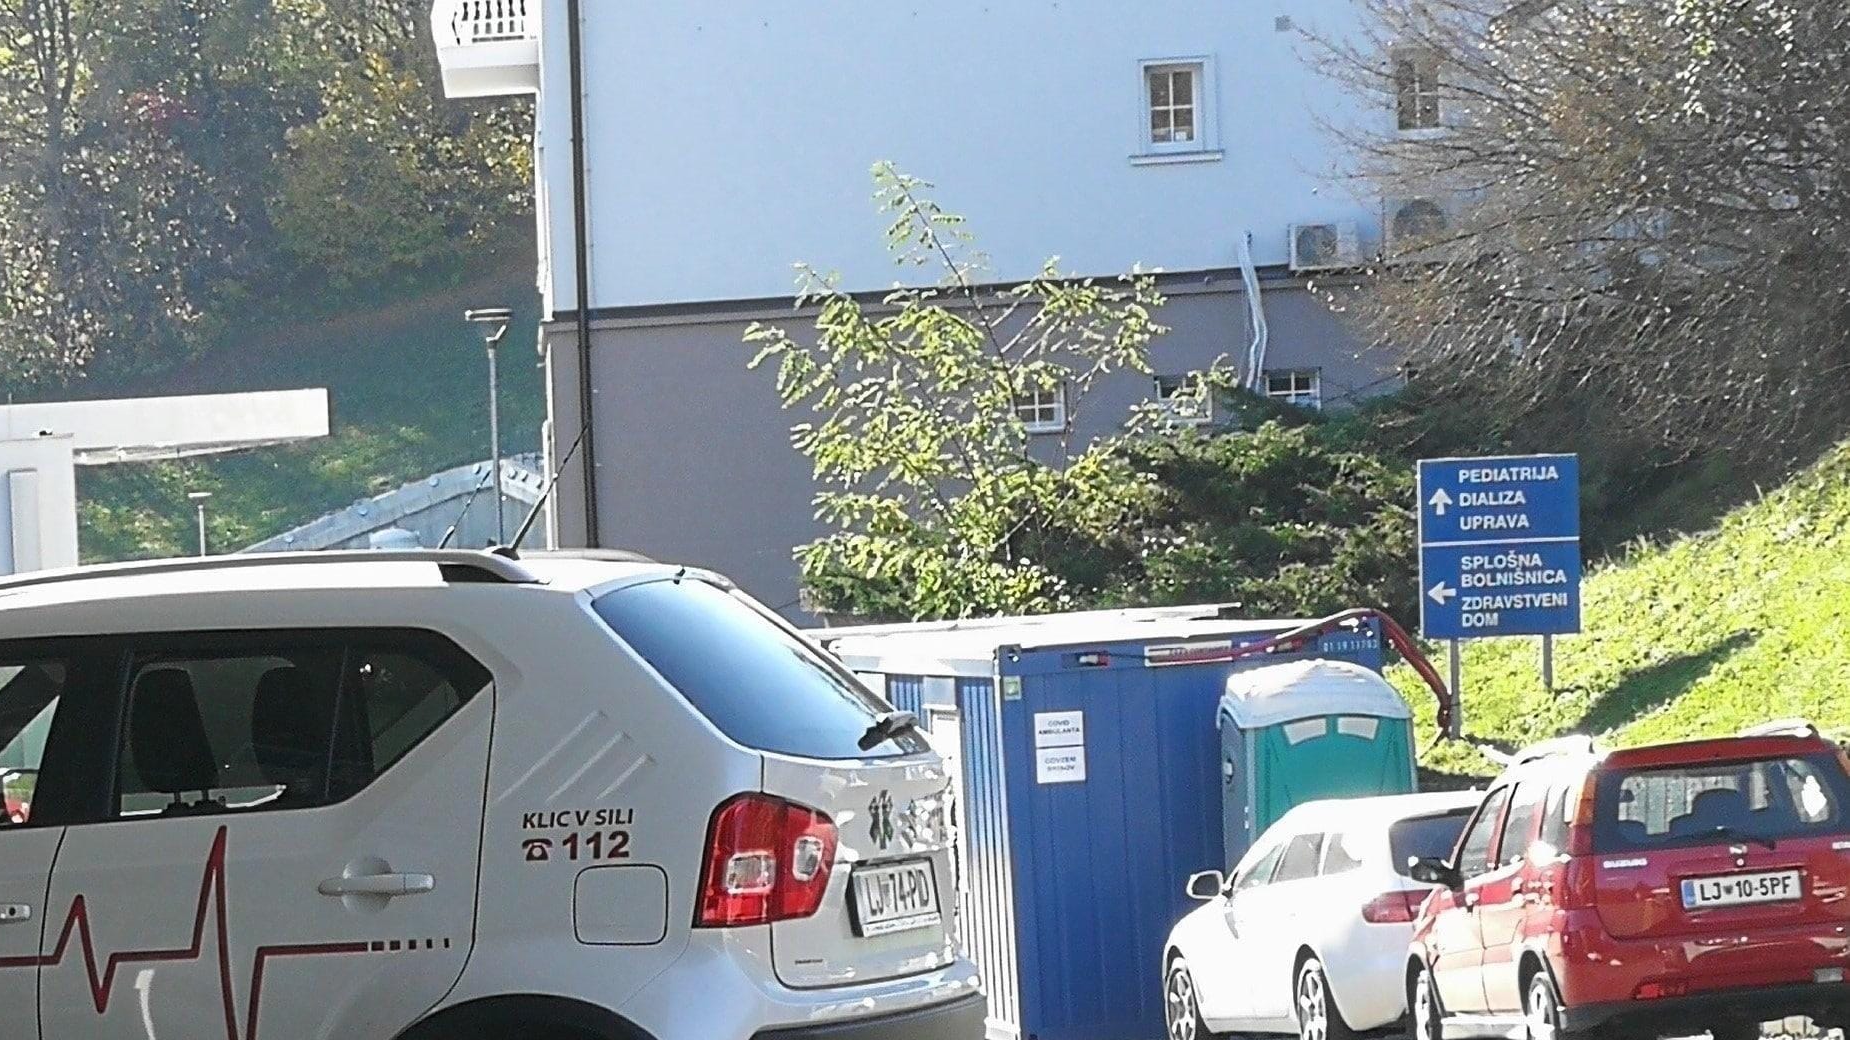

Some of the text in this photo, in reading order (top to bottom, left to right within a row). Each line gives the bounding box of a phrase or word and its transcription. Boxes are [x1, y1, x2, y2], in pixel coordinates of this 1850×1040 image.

[1458, 466, 1559, 483] PEDIATRIJA
[1459, 490, 1526, 507] DIALIZA
[1459, 514, 1530, 530] UPRAVA
[1461, 550, 1543, 571] SPLOŠNA
[1461, 569, 1567, 588] BOLNIŠNICA
[1461, 592, 1568, 611] ZDRAVSTVENI
[1461, 612, 1499, 627] DOM
[522, 808, 634, 829] KLIC V SILI
[562, 830, 630, 860] 112
[1700, 876, 1792, 902] LJ 10-5PF
